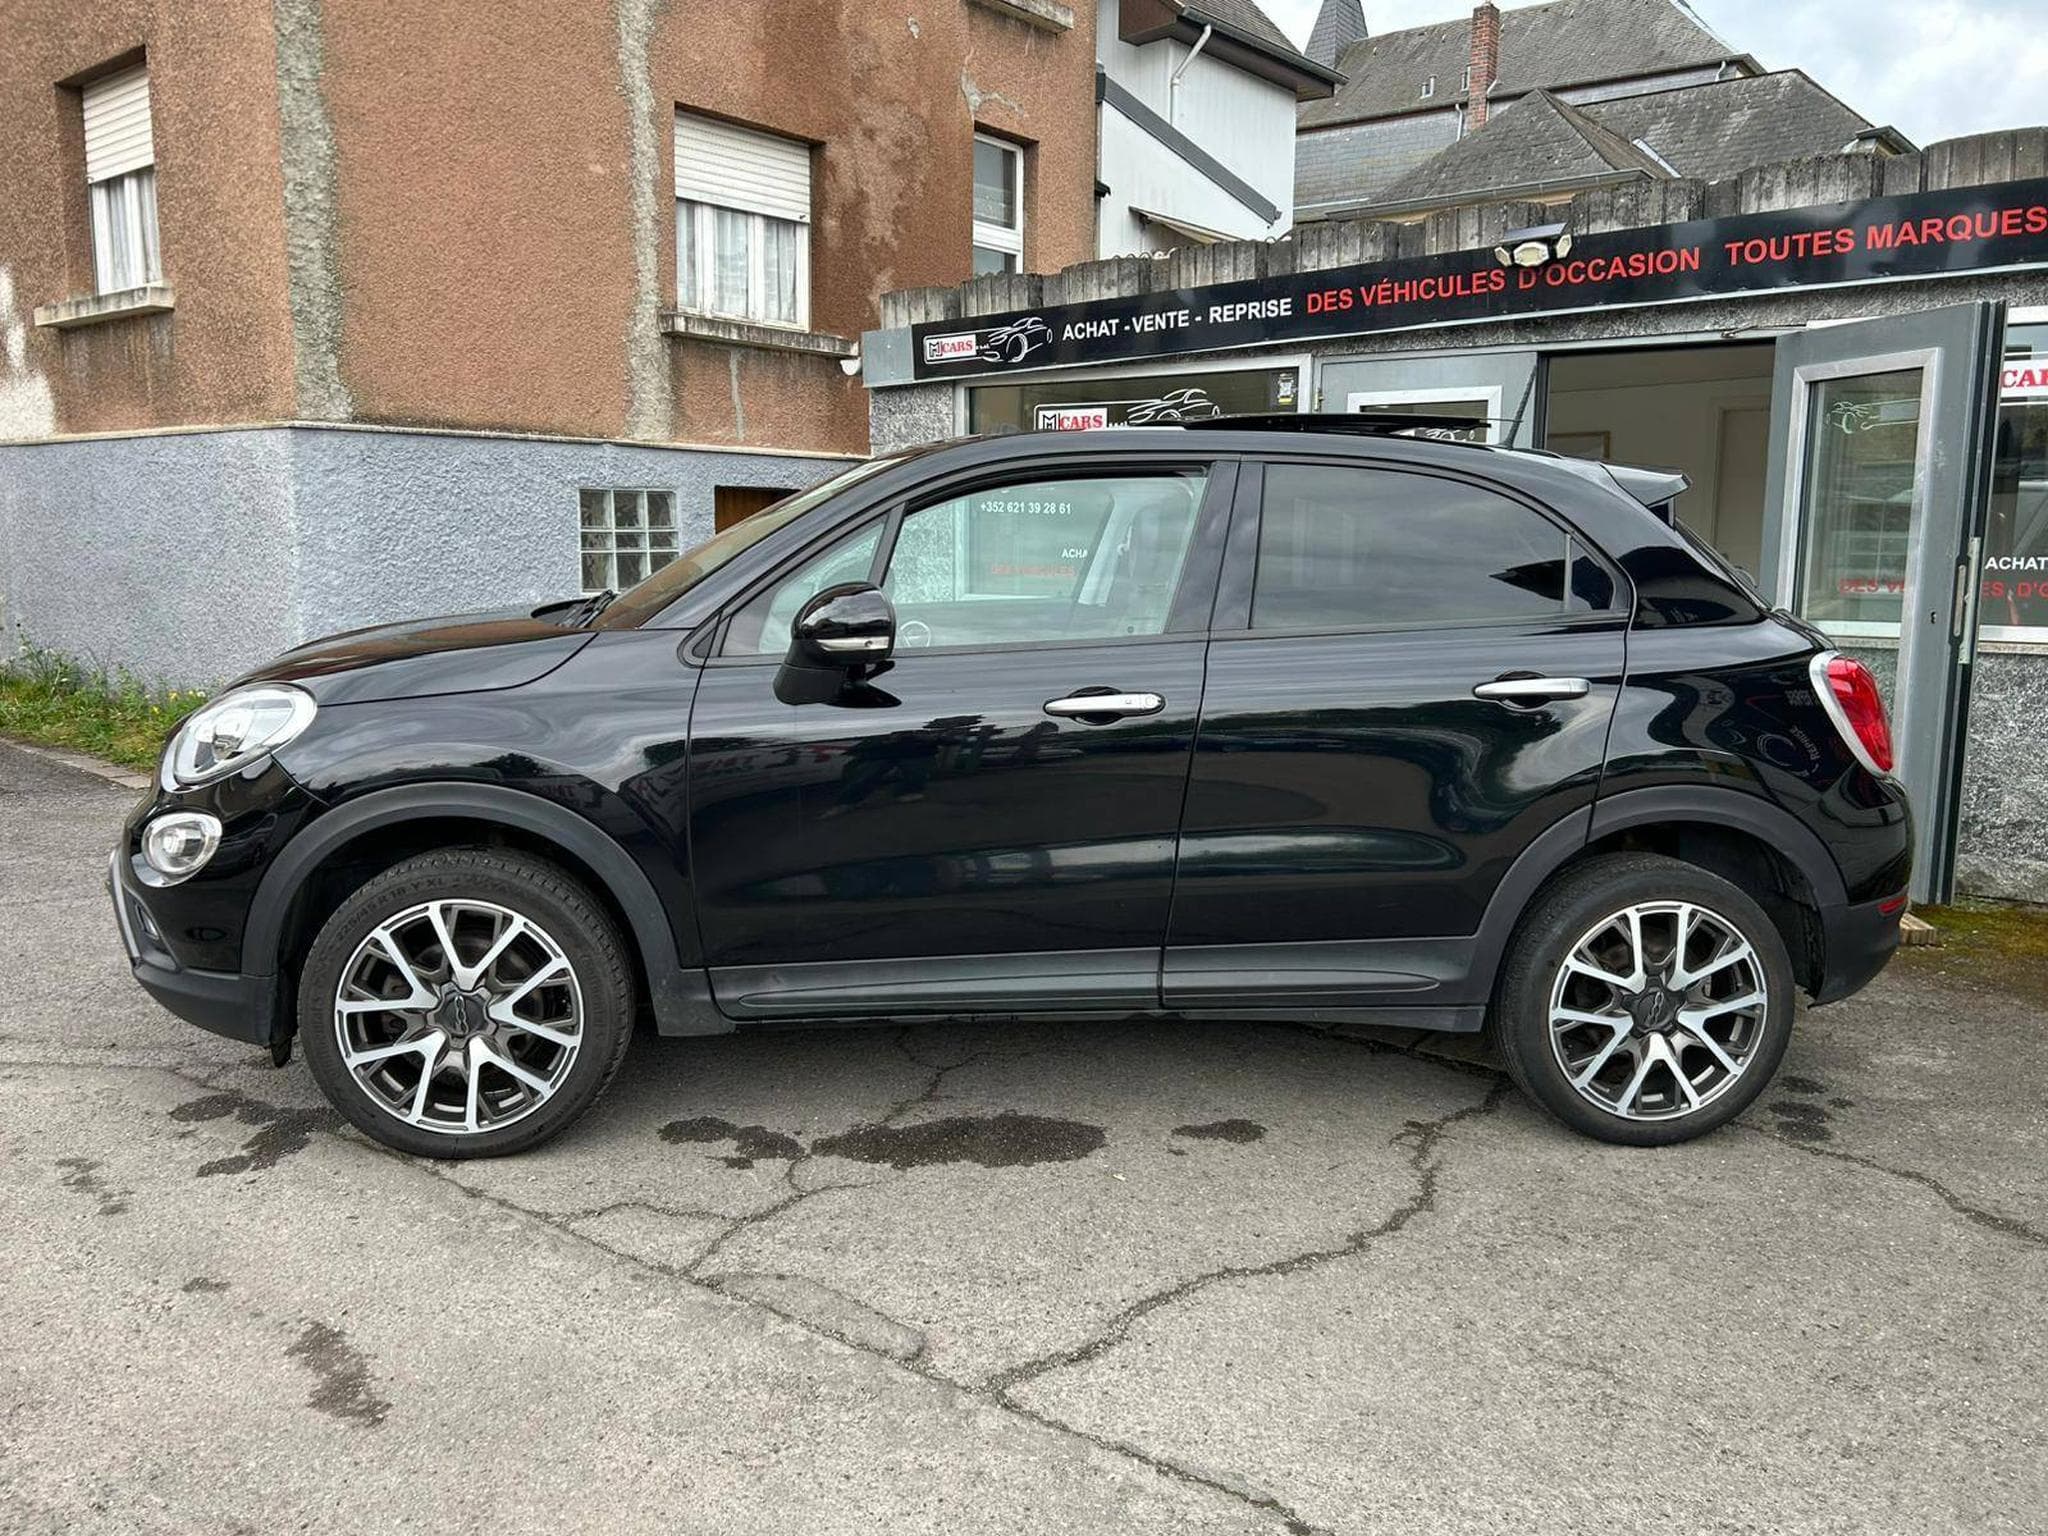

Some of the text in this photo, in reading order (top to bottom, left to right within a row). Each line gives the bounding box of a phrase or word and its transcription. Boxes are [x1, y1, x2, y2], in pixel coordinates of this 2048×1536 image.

[1062, 319, 1120, 341] ACHAT
[1131, 309, 1190, 334] VENTE
[1209, 298, 1293, 324] REPRISE
[1306, 288, 1355, 315] DES
[1359, 267, 1506, 307] VÉHICULES
[1517, 247, 1701, 291] D'OCCASION
[1725, 228, 1856, 267] TOUTES
[1865, 204, 2048, 251] MARQUES
[980, 501, 1071, 516] +352 621 39 28 61
[1984, 555, 2048, 570] ACHAT
